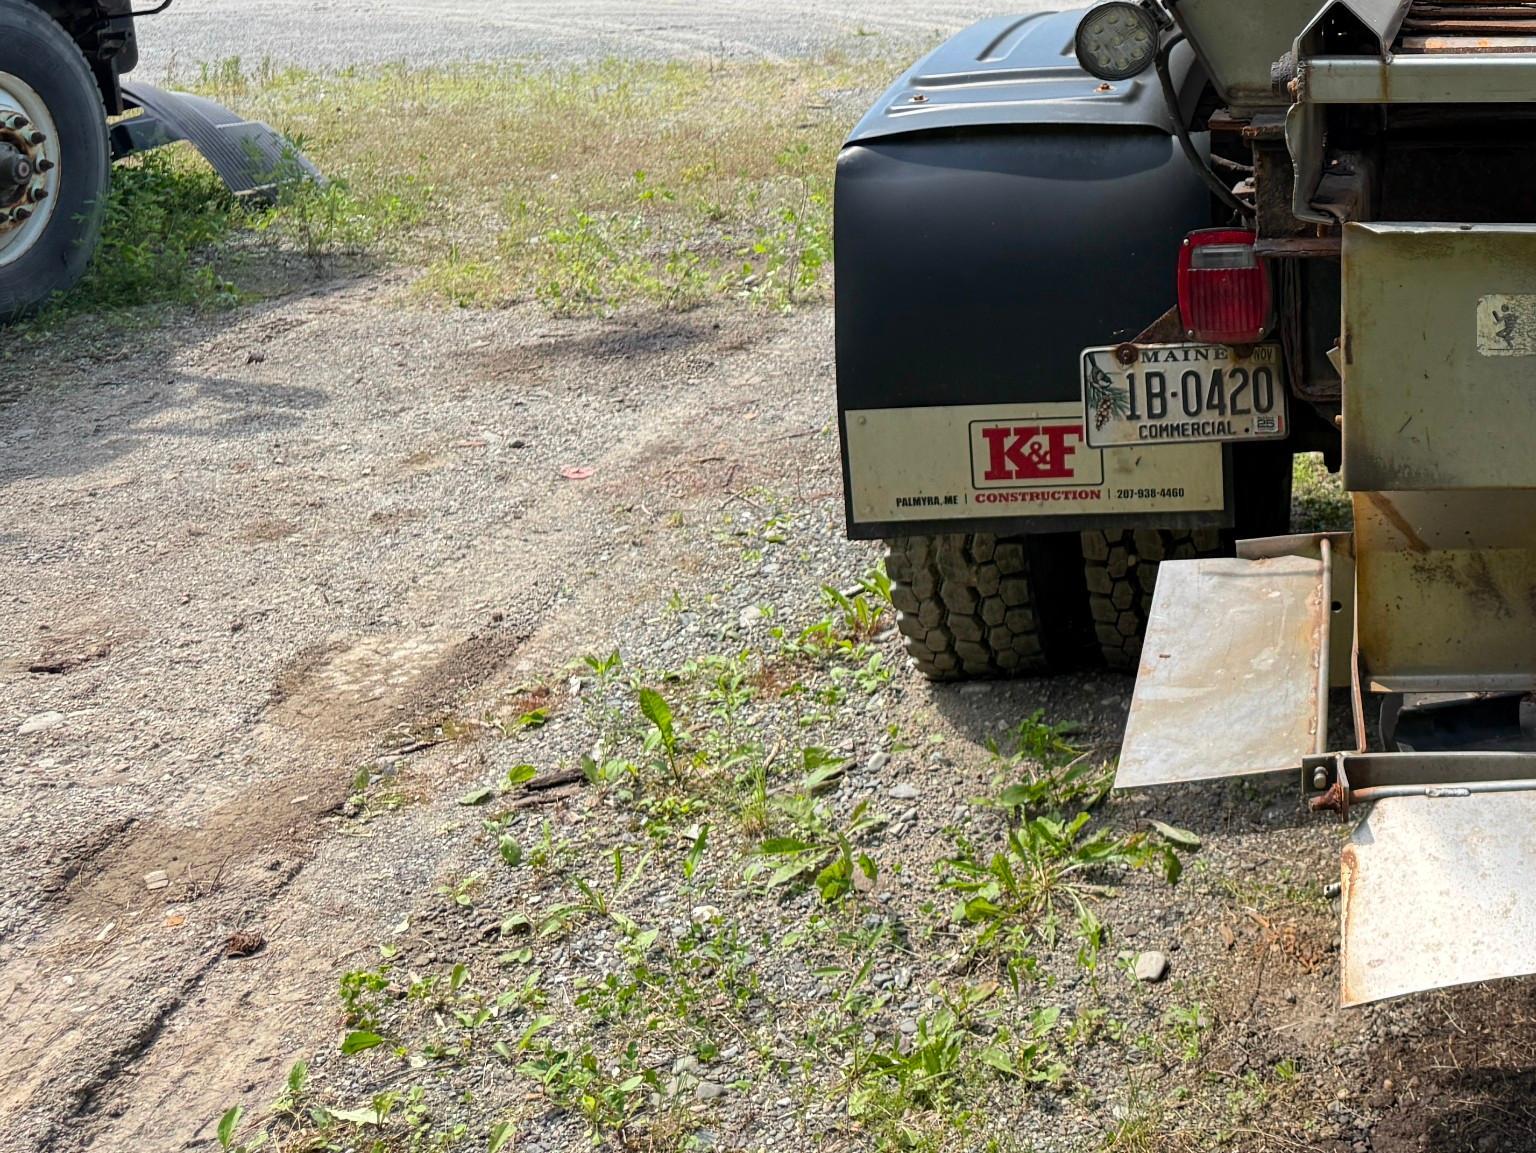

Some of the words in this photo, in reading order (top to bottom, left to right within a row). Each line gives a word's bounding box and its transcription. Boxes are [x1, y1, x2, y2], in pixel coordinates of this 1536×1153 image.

[1141, 348, 1229, 363] MAINE
[1254, 348, 1273, 361] NOV
[1138, 421, 1236, 440] COMMERCIAL
[982, 423, 1084, 481] K&F
[944, 495, 959, 505] ME
[975, 489, 1102, 504] CONSTRUCTION
[1116, 488, 1185, 499] 207-938-4460
